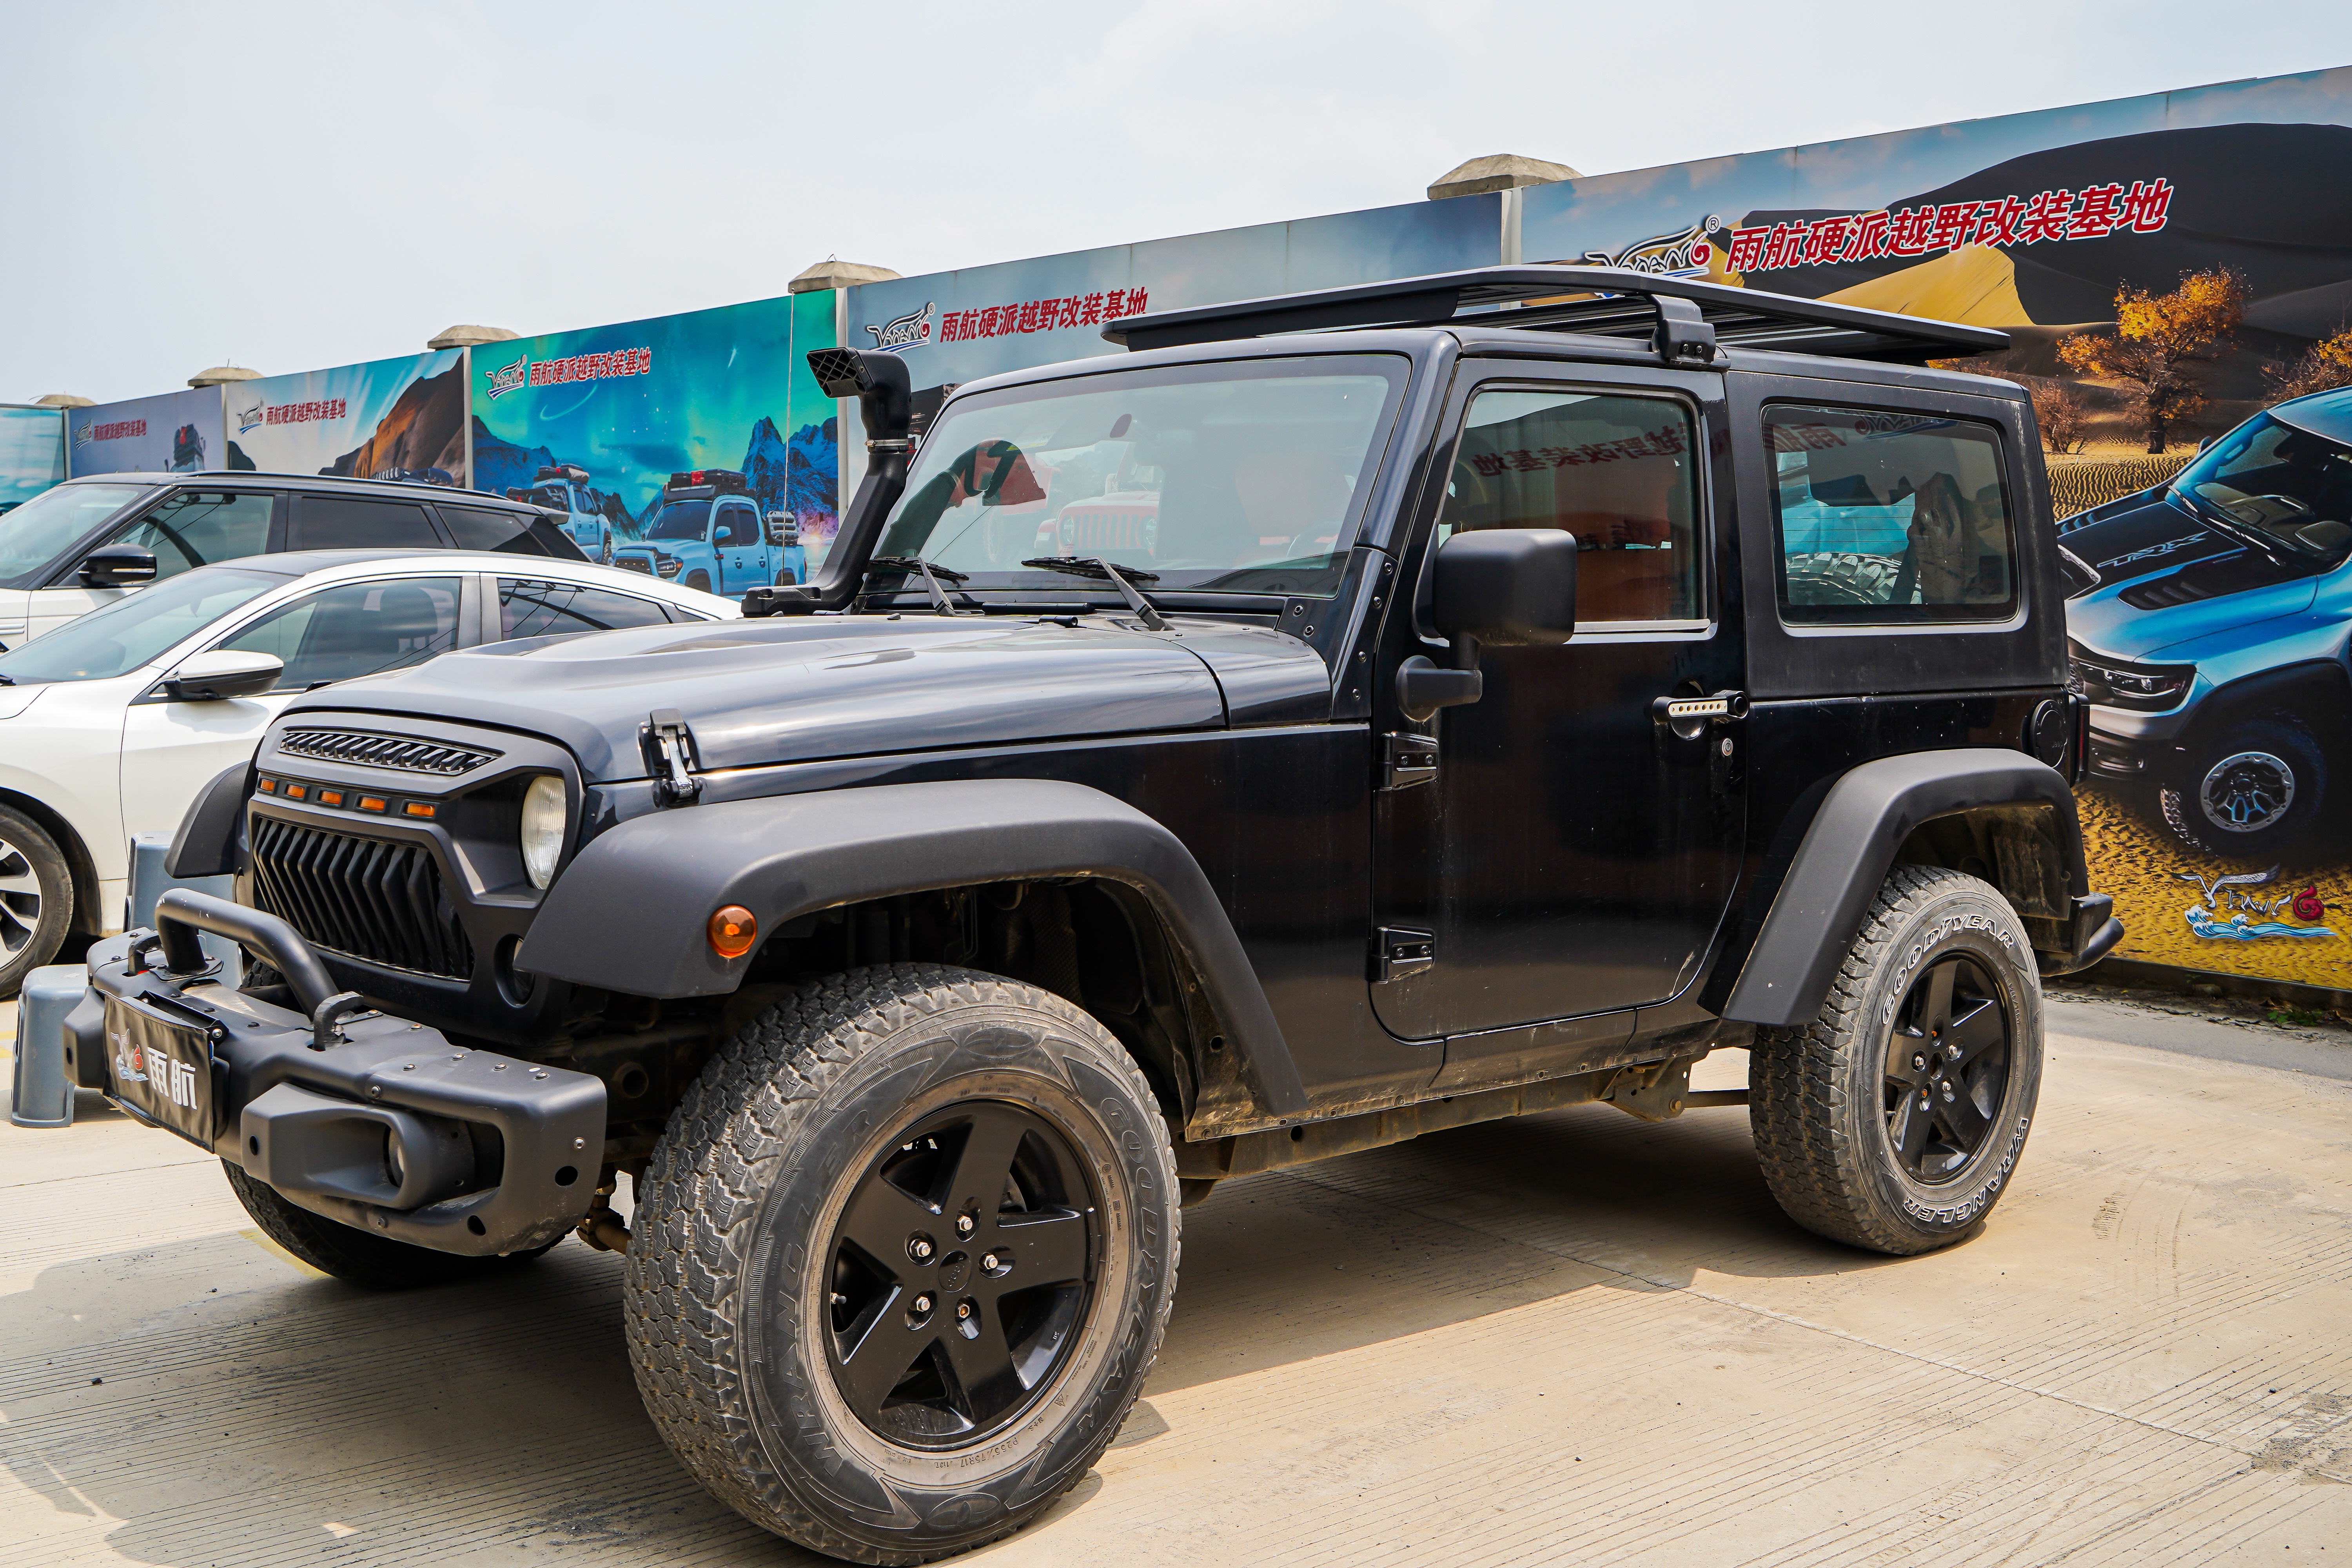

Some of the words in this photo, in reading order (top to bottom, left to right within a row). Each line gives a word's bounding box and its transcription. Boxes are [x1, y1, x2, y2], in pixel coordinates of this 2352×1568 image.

[1725, 179, 2173, 274] 雨航硬派越野改装基地
[940, 287, 1149, 343] 雨航硬派越野改装基地
[529, 347, 651, 387] 雨航硬派越野改装基地
[267, 399, 347, 425] 雨航硬派越野改装基地
[1883, 914, 2014, 1025] GOODYEAR
[147, 1046, 197, 1110] 雨航
[1903, 1117, 2029, 1223] WRANGLER
[779, 1110, 870, 1478] WRANGLER
[947, 1256, 965, 1287] Jeep
[1079, 1098, 1158, 1439] GOODYEAR
[960, 1438, 1018, 1467] P255/75R17
